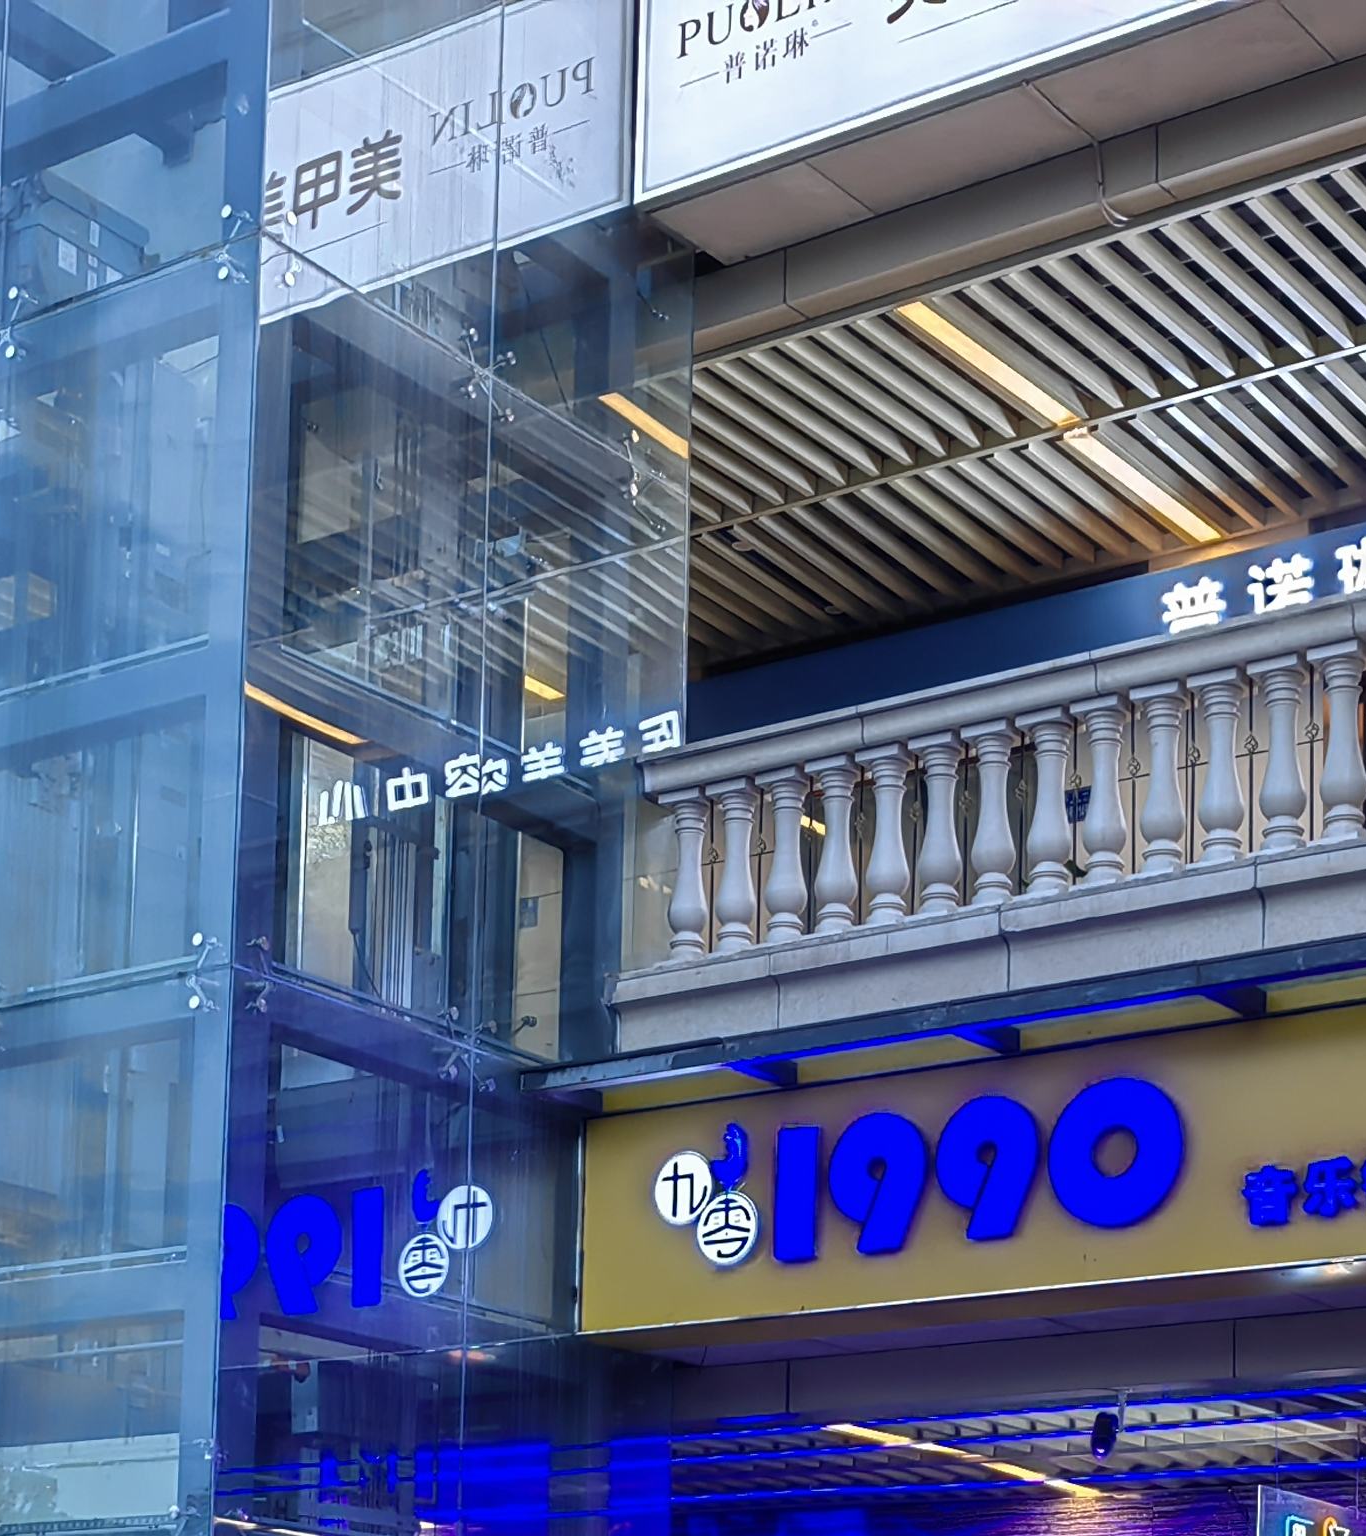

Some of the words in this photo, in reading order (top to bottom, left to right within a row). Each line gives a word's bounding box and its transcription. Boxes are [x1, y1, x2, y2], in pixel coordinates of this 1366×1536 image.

[676, 0, 830, 58] PUOL
[723, 27, 809, 84] 普诺琳
[771, 1076, 1186, 1262] 1990
